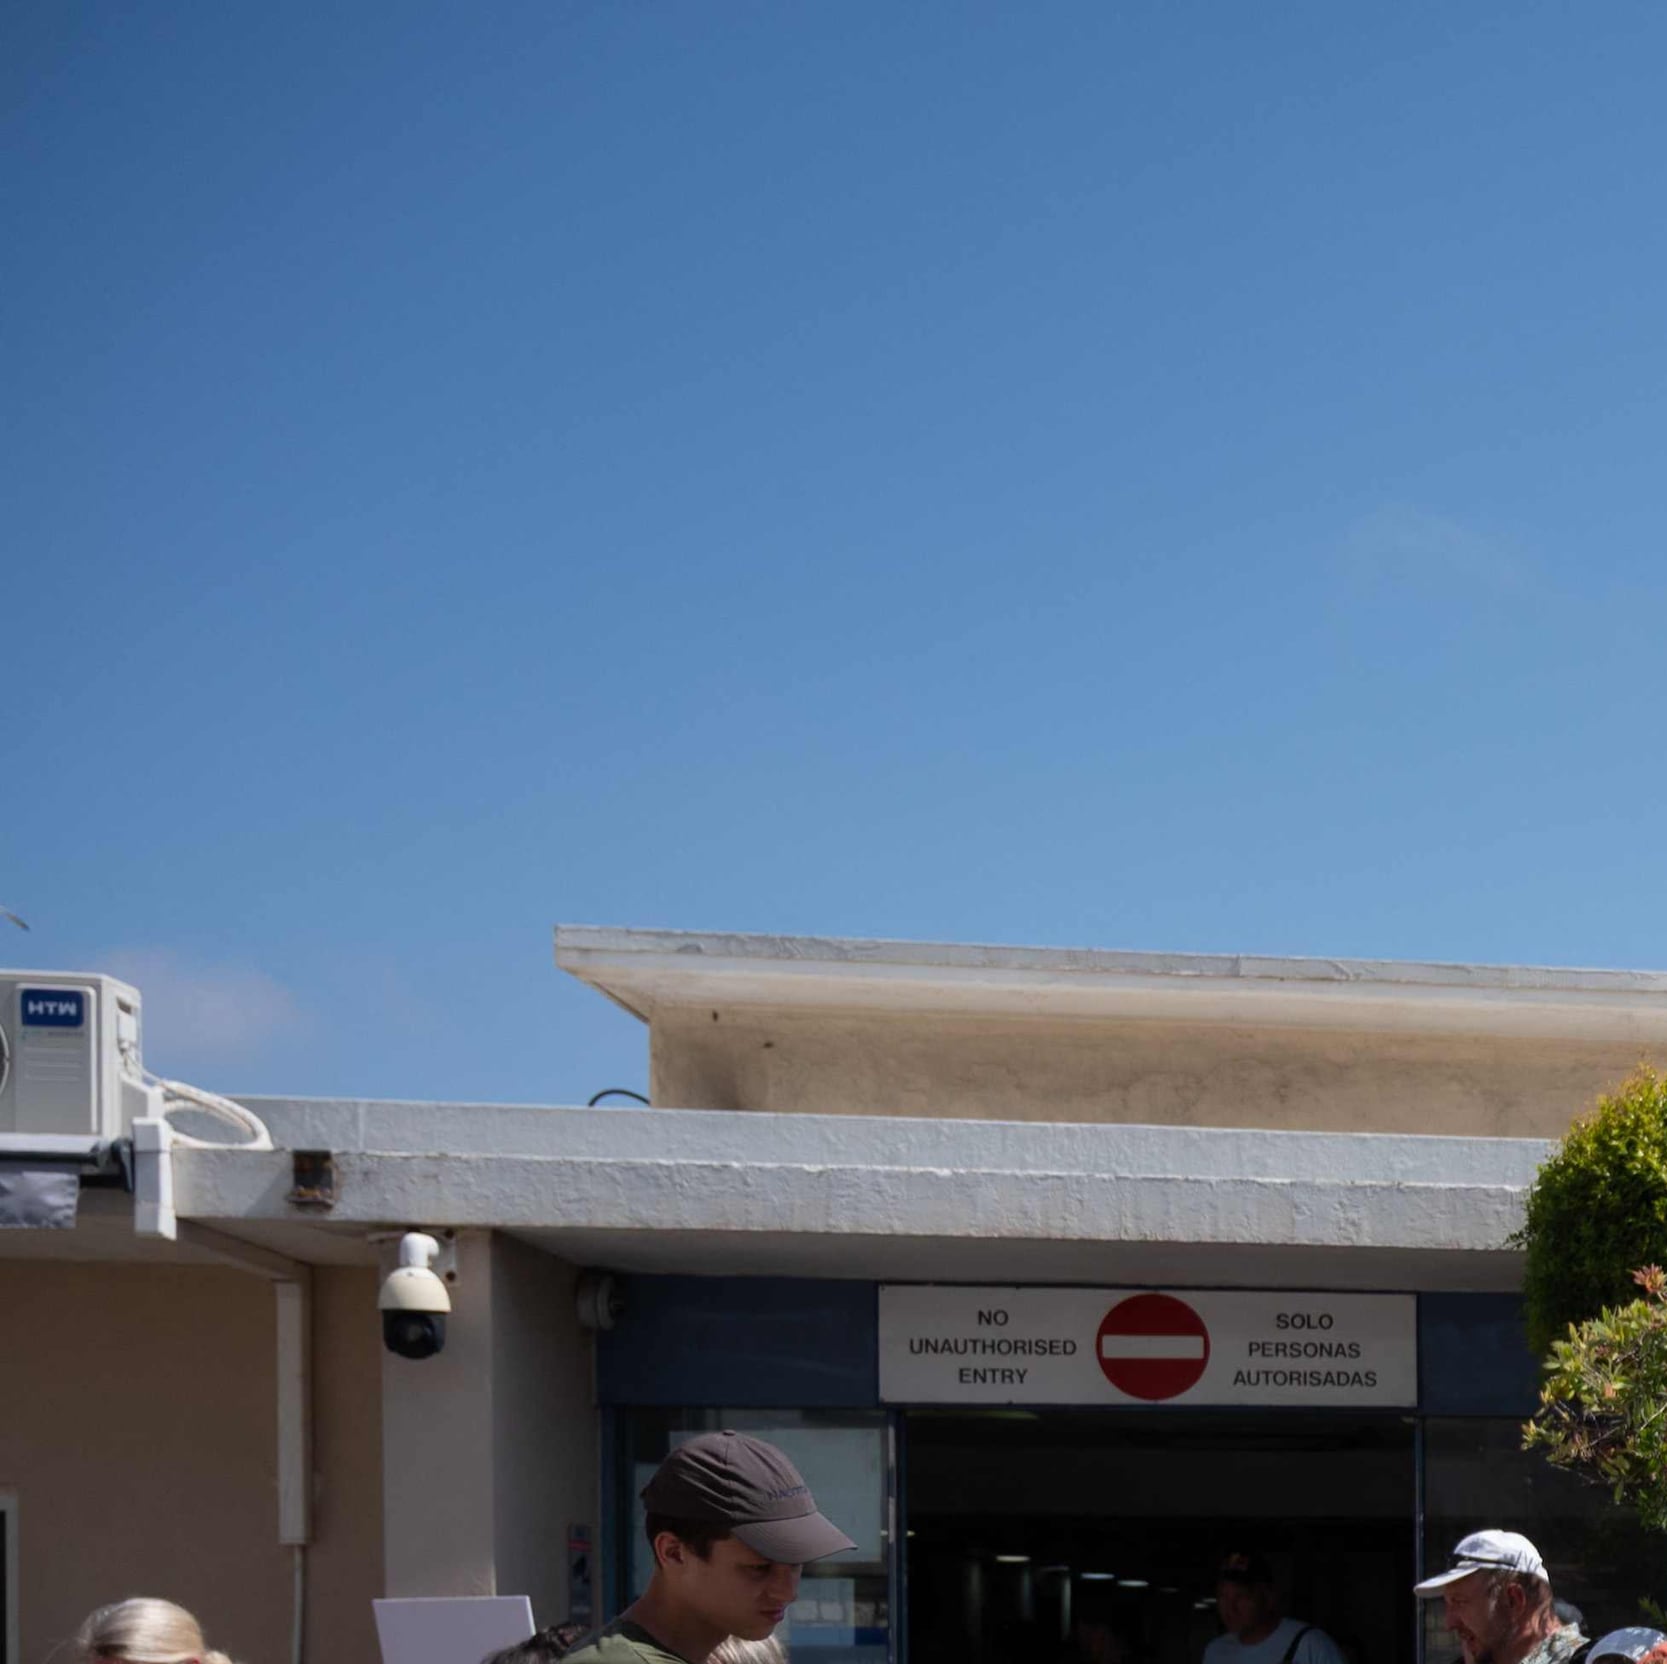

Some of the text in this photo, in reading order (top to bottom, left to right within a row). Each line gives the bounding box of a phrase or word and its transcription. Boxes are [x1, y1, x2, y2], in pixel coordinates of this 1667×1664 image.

[27, 1000, 77, 1016] HTW
[977, 1309, 1009, 1327] NO
[1275, 1313, 1334, 1331] SOLO
[909, 1337, 1077, 1357] UNAUTHORISED
[1248, 1341, 1361, 1359] PERSONAS
[958, 1367, 1028, 1385] ENTRY
[1233, 1369, 1377, 1388] AUTORISADAS
